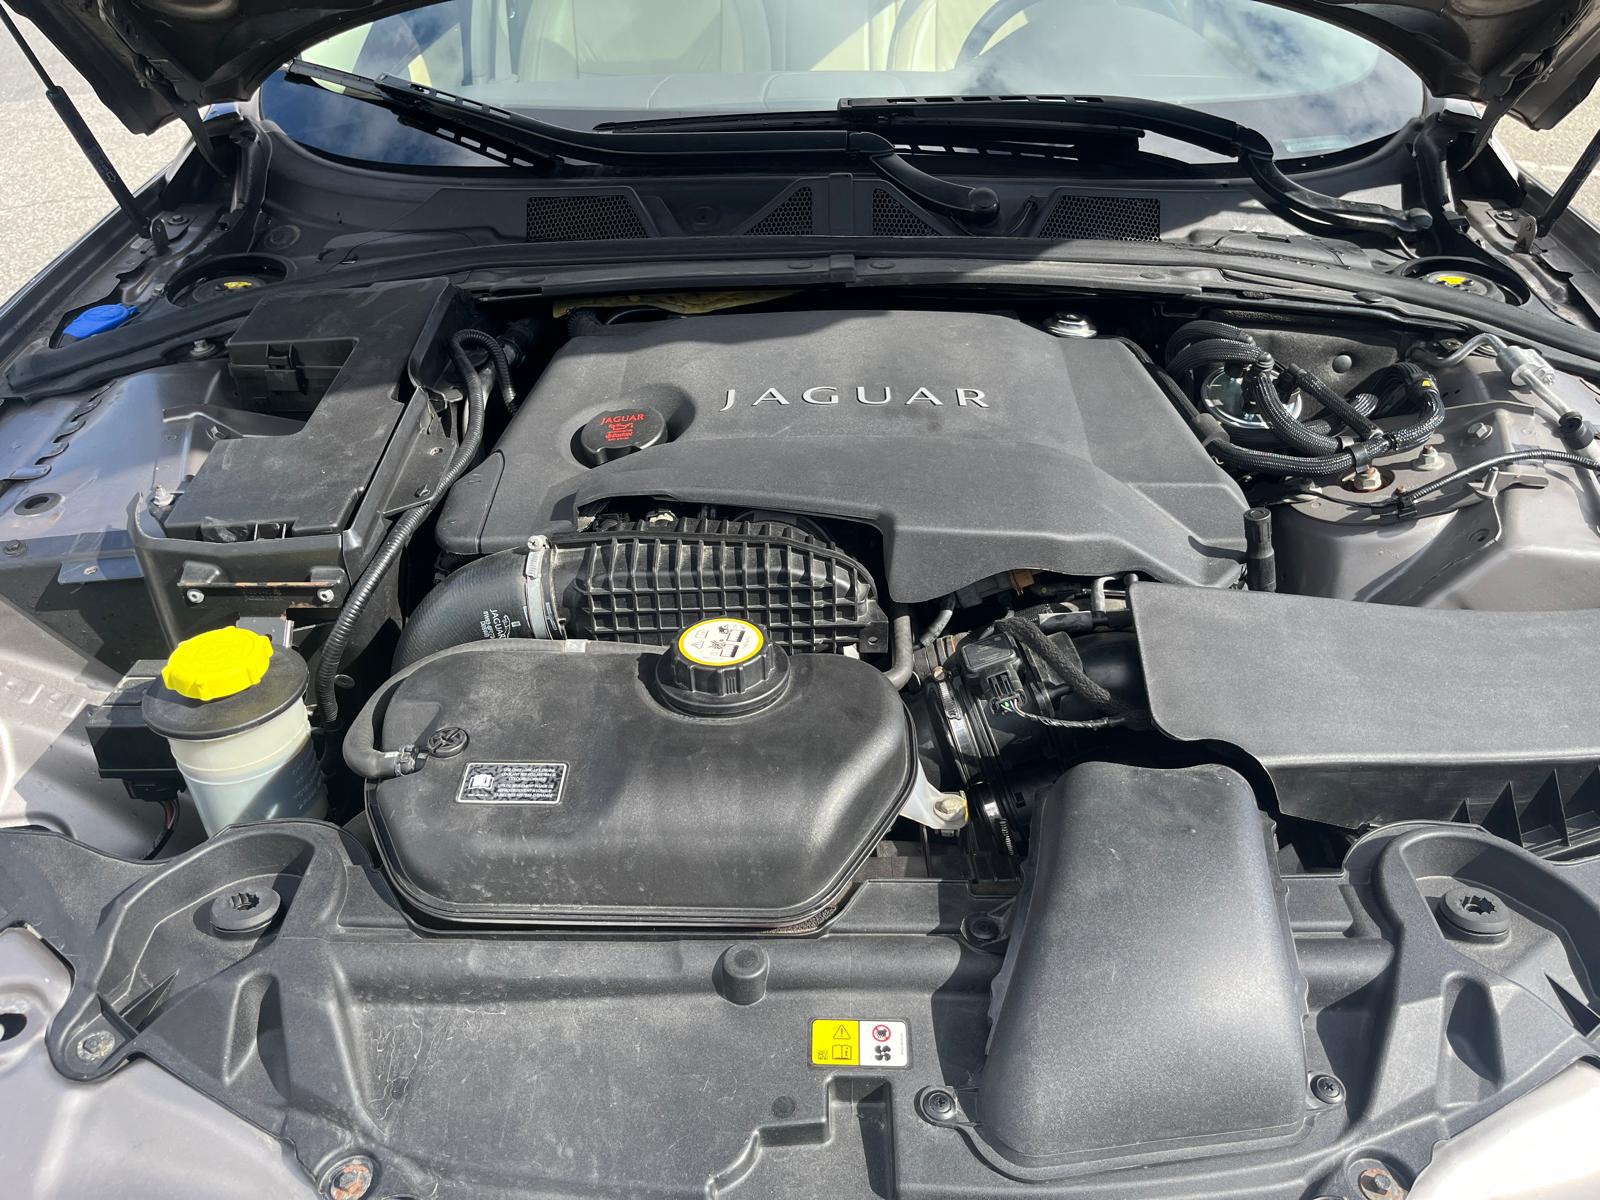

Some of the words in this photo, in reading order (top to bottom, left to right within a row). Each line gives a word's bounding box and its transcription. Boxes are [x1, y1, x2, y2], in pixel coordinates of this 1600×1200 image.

[720, 386, 990, 412] JAGUAR
[600, 413, 646, 425] JAGUAR
[490, 609, 506, 639] JAGUAR
